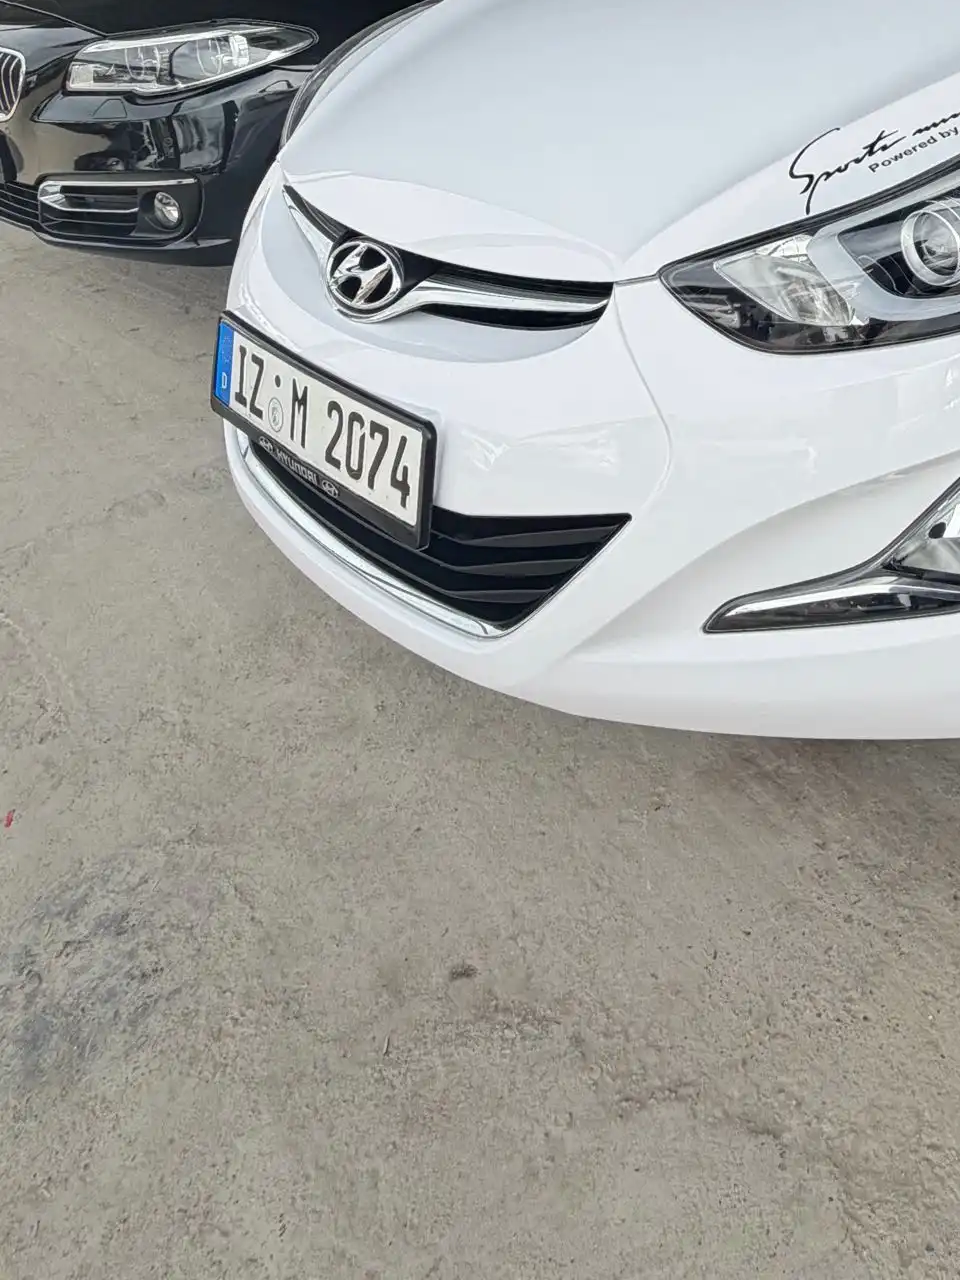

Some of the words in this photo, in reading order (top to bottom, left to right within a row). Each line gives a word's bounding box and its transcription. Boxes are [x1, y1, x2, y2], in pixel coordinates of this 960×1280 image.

[867, 137, 937, 174] Powered
[938, 125, 960, 143] by
[221, 371, 228, 390] D
[234, 344, 265, 421] IZ
[289, 377, 309, 450] M
[324, 400, 411, 509] 2074
[276, 448, 318, 486] HYUNDAI
